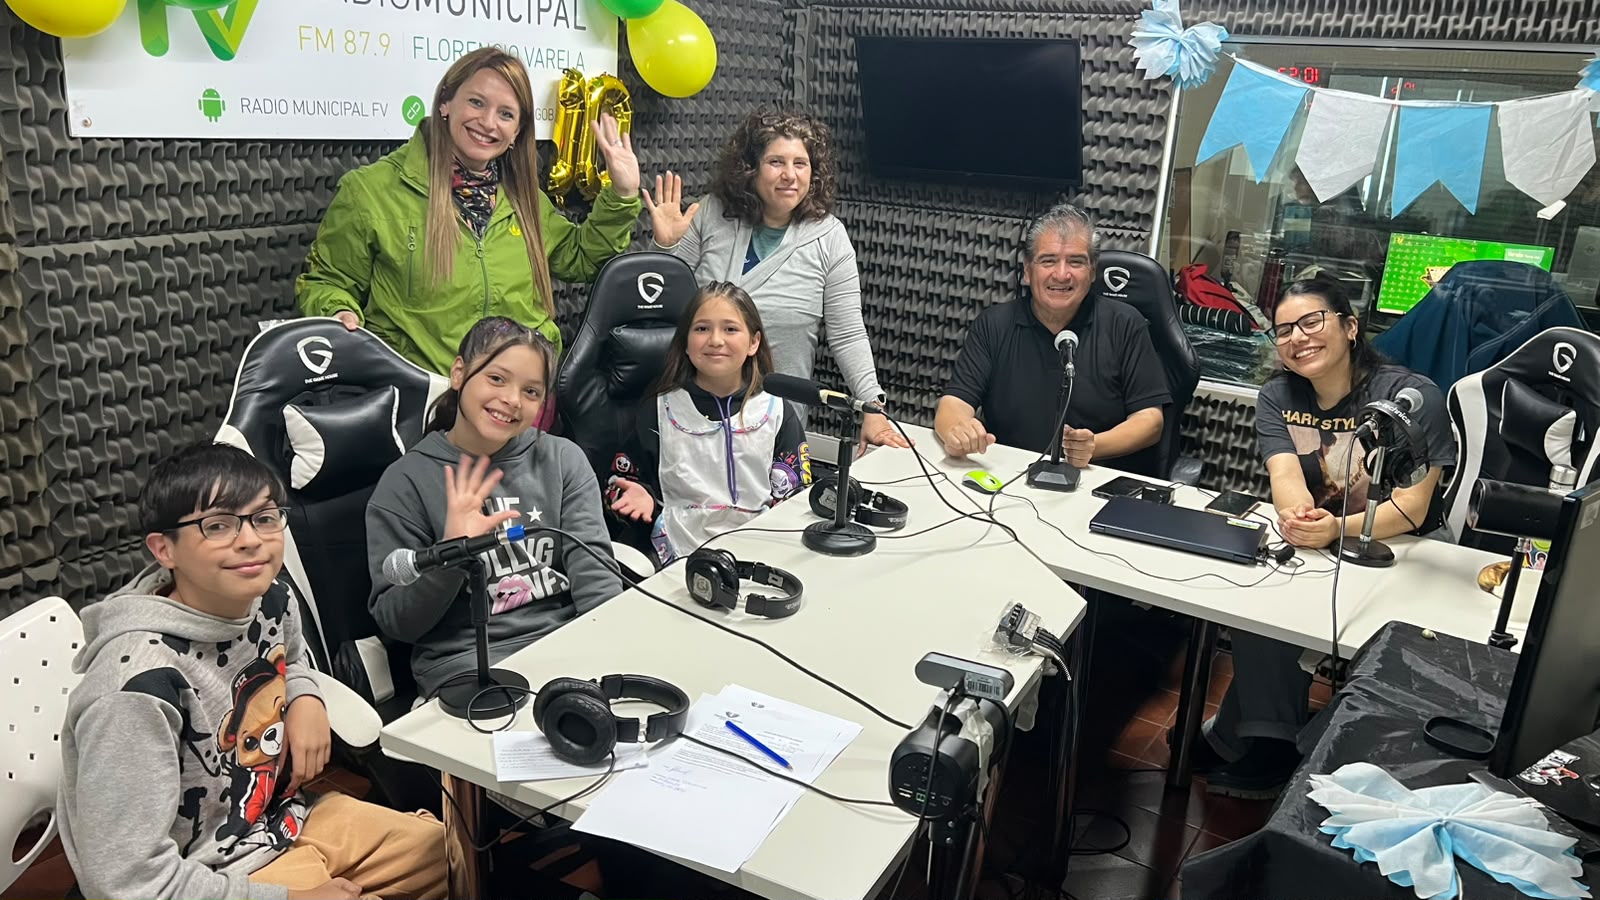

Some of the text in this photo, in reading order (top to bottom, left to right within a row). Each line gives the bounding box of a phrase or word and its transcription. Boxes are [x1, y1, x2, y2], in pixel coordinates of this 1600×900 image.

[298, 25, 391, 57] FM 87.9
[412, 36, 586, 71] FLOREO VARELA
[240, 97, 389, 118] RADIO MUNICIPAL FV
